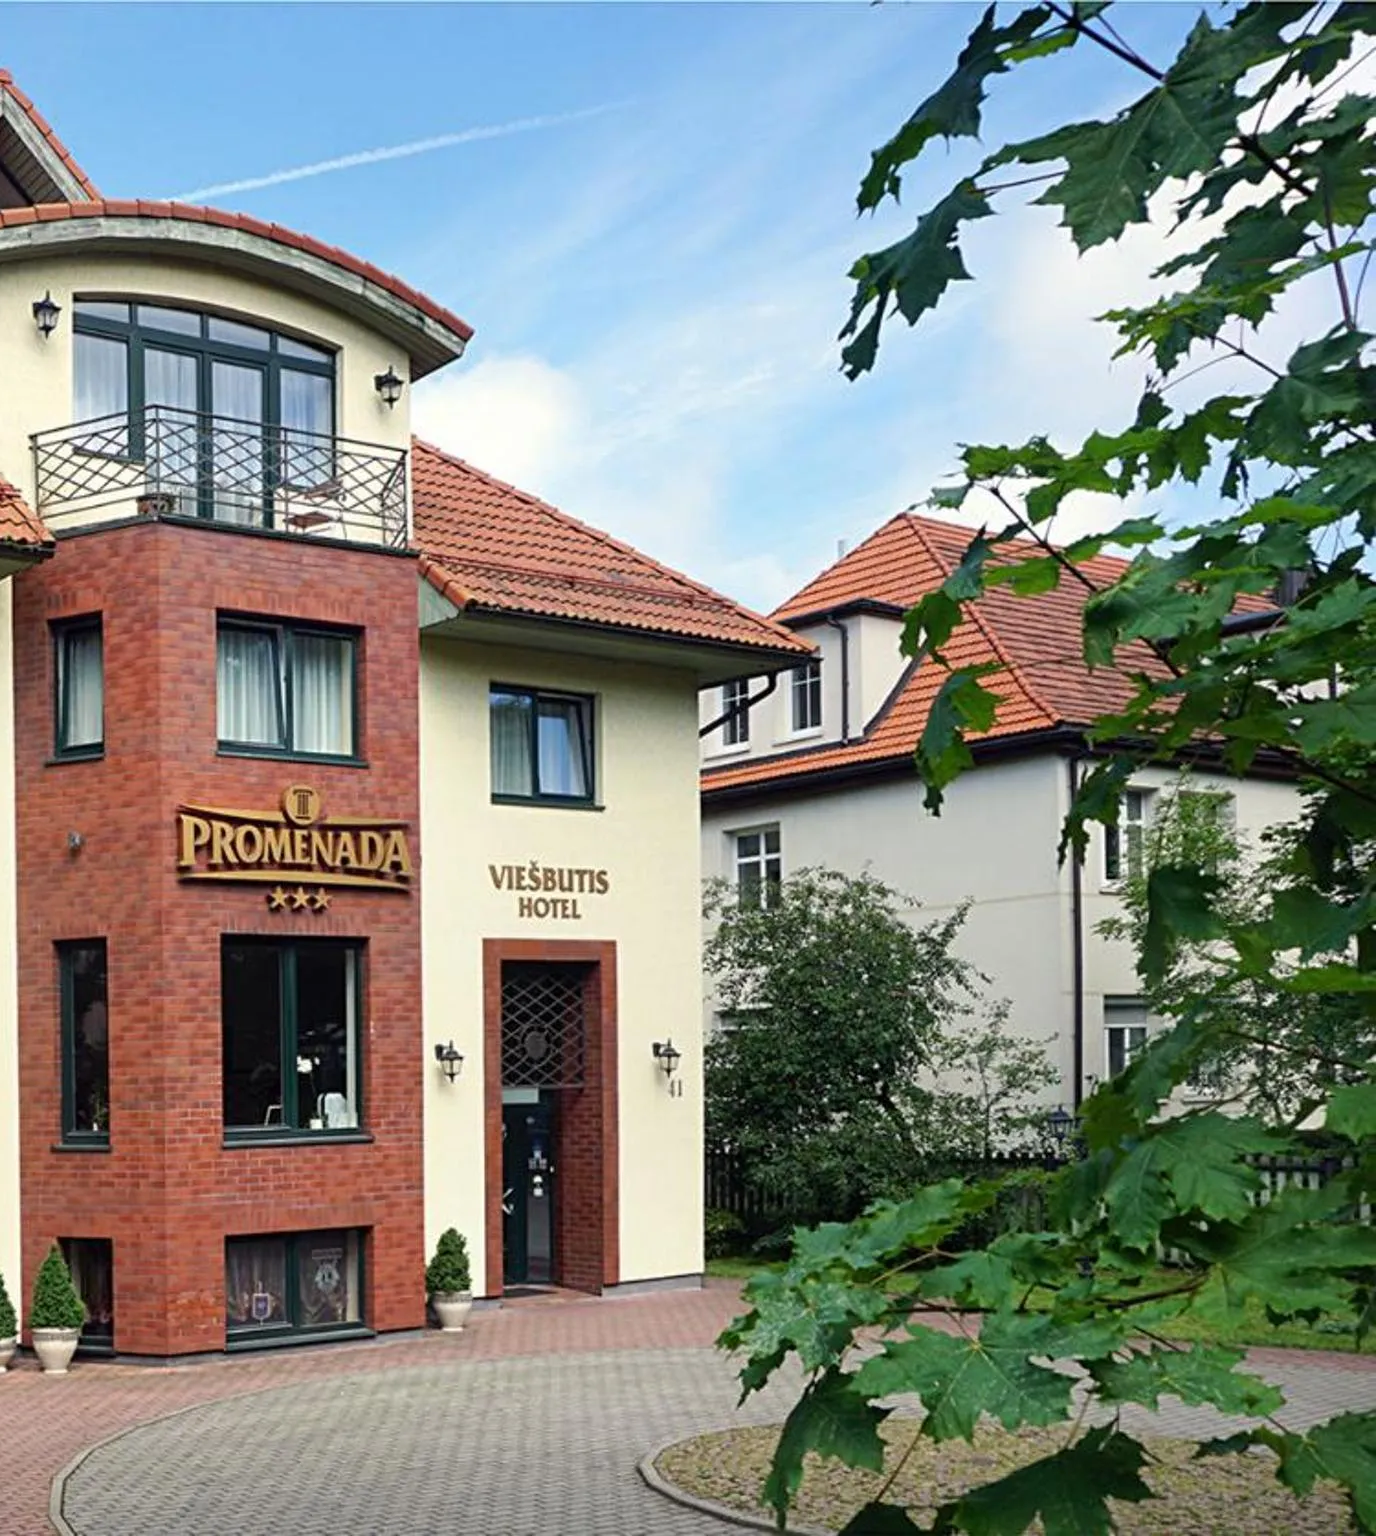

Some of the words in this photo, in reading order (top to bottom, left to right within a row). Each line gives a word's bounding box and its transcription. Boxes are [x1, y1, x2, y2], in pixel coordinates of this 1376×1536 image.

[179, 813, 414, 878] PROMENADA
[488, 860, 610, 894] VIEŠBUTIS
[518, 897, 582, 919] HOTEL
[667, 1079, 682, 1098] 41
